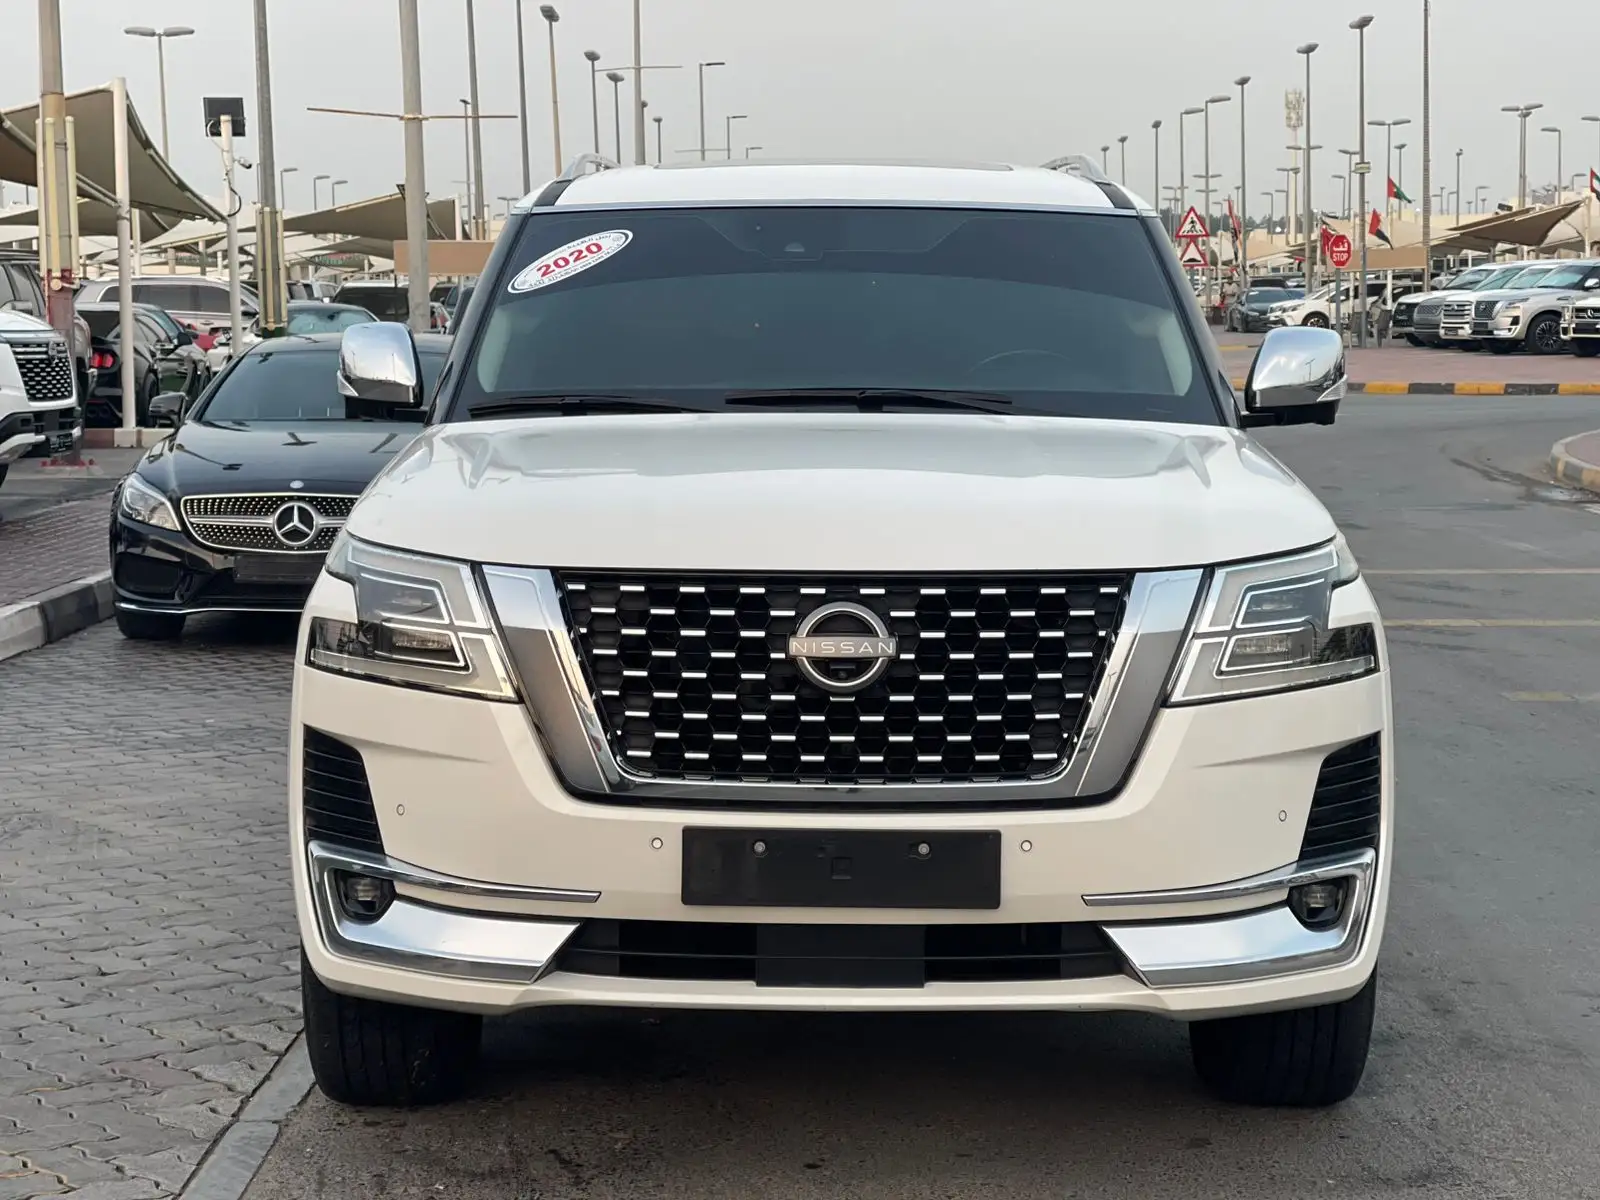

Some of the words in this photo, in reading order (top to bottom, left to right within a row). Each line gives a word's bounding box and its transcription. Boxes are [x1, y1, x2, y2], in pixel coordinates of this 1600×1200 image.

[537, 243, 603, 278] 2020
[1333, 253, 1349, 262] STOP
[792, 642, 893, 654] NISSAN
